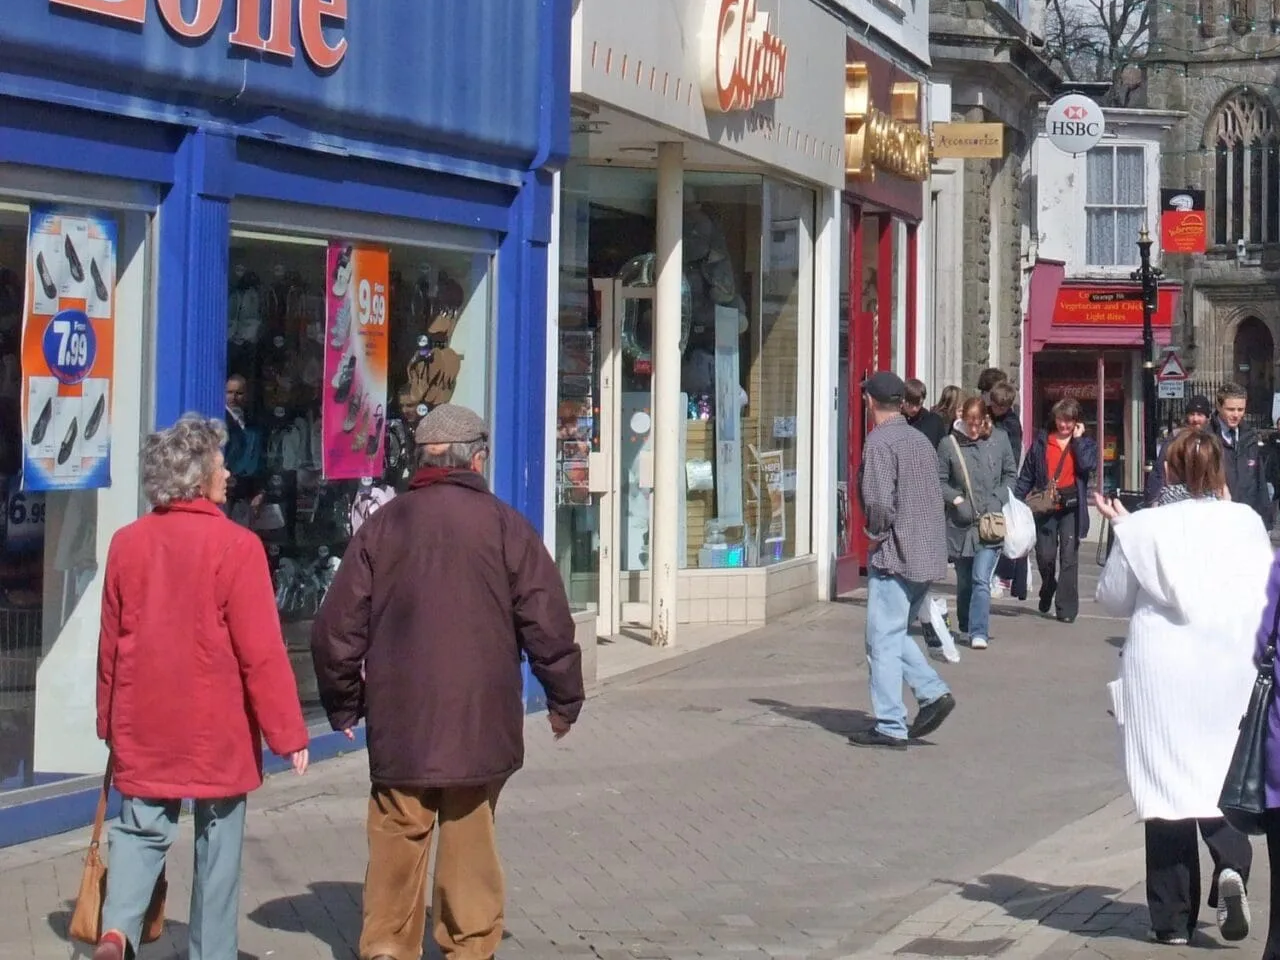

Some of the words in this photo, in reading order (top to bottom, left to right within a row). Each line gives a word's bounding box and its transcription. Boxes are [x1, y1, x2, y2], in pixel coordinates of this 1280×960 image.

[1051, 121, 1099, 136] HSBC
[937, 134, 1000, 148] Accessorize
[359, 279, 385, 325] 9.99
[1060, 301, 1101, 313] Vegetarian
[1104, 301, 1119, 311] and
[1122, 302, 1143, 312] Chick
[1086, 313, 1105, 322] Light
[1107, 313, 1126, 321] Bites
[53, 321, 88, 366] 7.99
